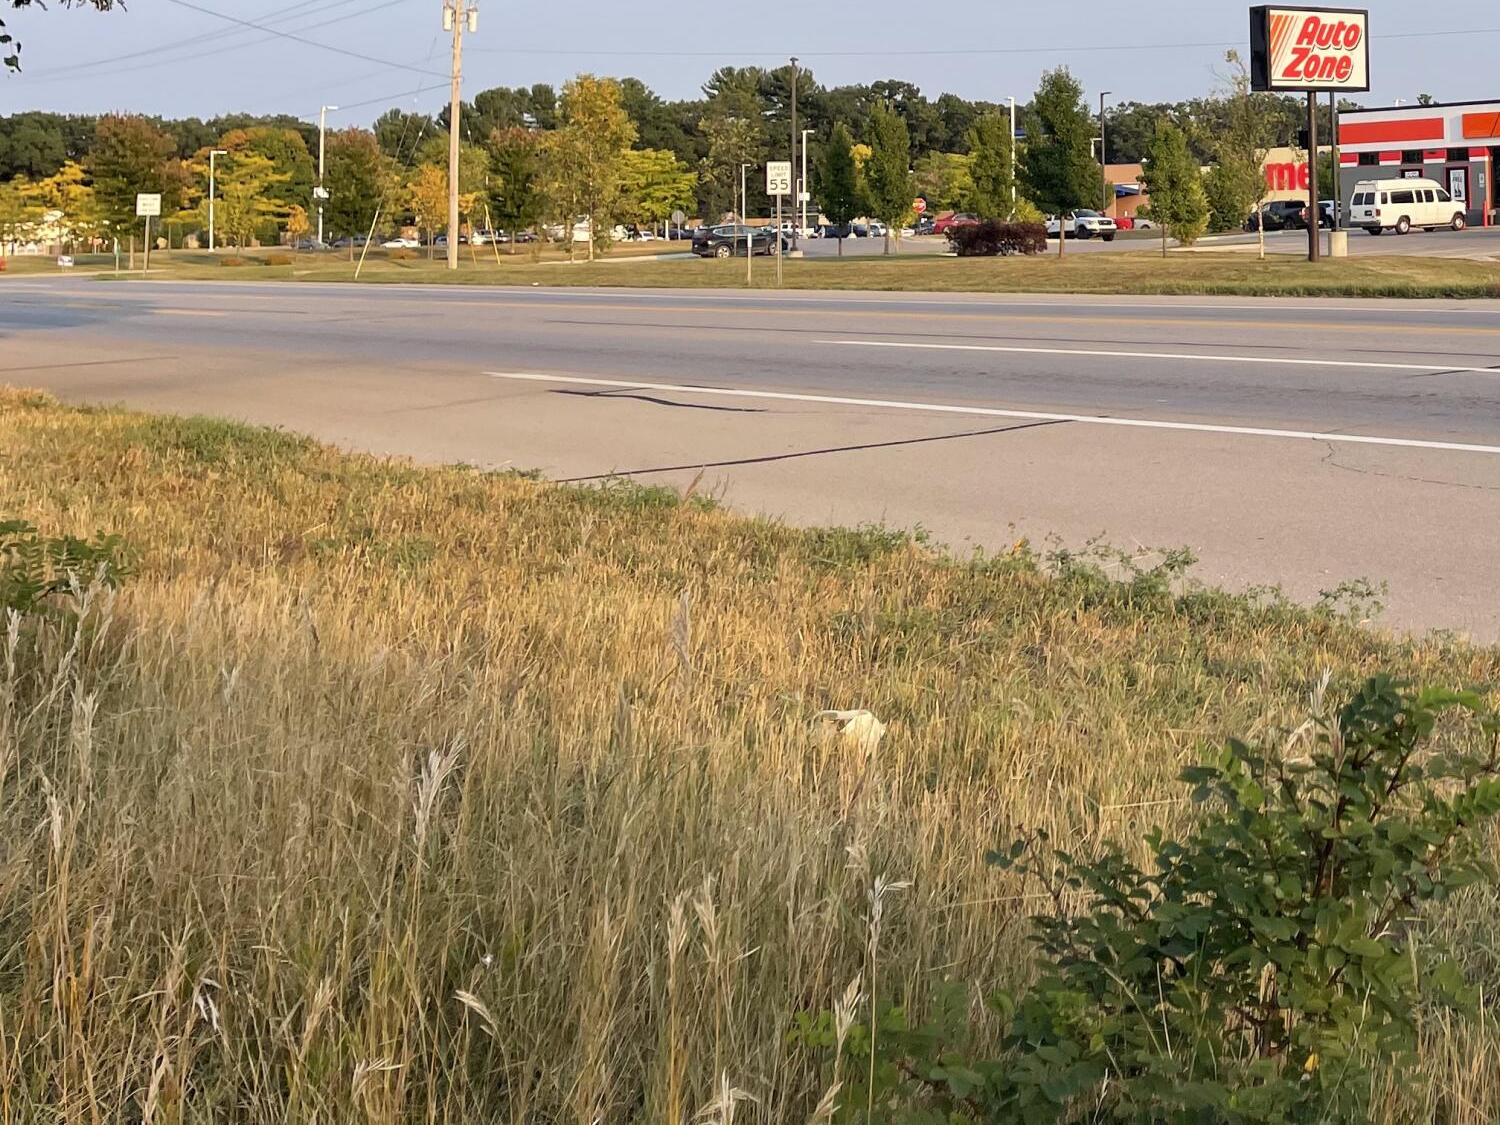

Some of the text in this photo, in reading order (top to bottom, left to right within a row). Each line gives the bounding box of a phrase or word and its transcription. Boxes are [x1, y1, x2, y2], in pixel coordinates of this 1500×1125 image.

[1296, 16, 1361, 49] Auto
[1282, 47, 1352, 81] Zone
[770, 178, 788, 190] 55
